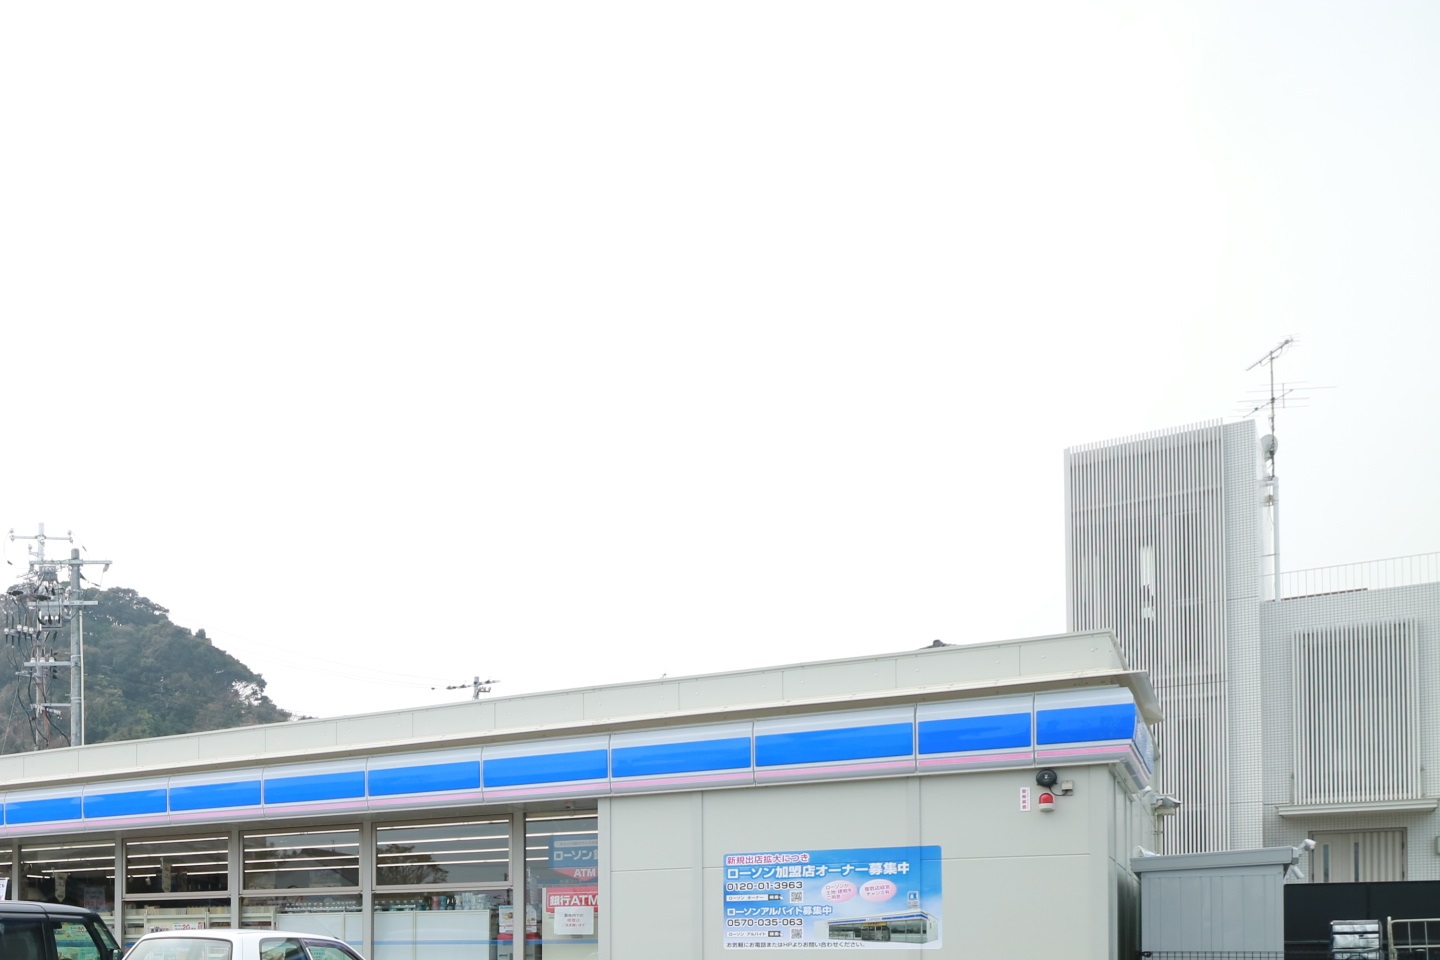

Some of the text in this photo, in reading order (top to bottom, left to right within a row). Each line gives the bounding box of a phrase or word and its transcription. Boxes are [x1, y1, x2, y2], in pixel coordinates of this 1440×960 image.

[727, 853, 809, 865] 新規出店拡大につき
[573, 868, 596, 878] ATM
[727, 861, 910, 879] ローソン加盟店オーナー募集中
[727, 881, 803, 891] 0120-01-3963
[549, 894, 598, 906] 銀行ATM
[727, 905, 833, 917] ローソンアルバイト募集中
[727, 918, 803, 928] 0570-035-063
